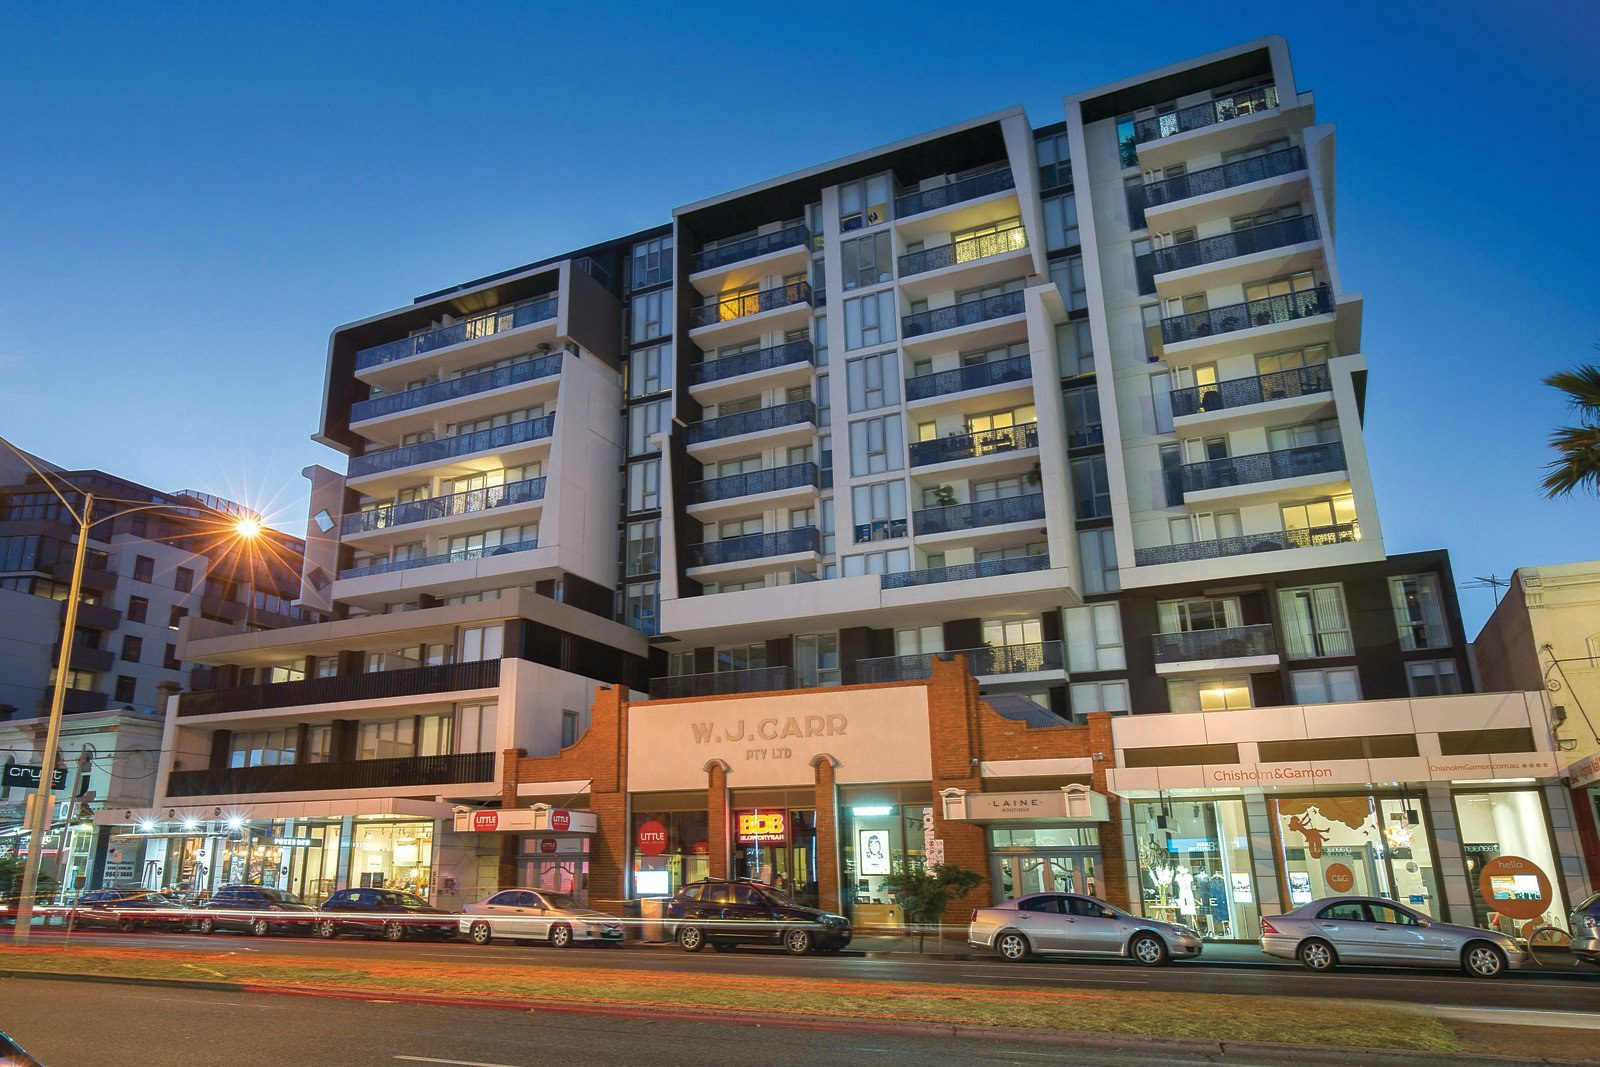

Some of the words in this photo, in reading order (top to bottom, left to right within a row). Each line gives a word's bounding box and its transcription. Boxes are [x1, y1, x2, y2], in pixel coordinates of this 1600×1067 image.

[746, 749, 767, 760] PTY
[772, 748, 792, 759] LTD
[10, 767, 62, 780] crut
[1213, 767, 1333, 782] Chisholm&Gamon
[993, 799, 1038, 807] LAINE
[476, 816, 496, 824] LITTLE
[553, 815, 568, 823] LITTLE
[740, 814, 785, 835] BDB
[640, 832, 665, 841] LITTLE
[1497, 860, 1523, 869] hello
[1331, 874, 1349, 882] C&G
